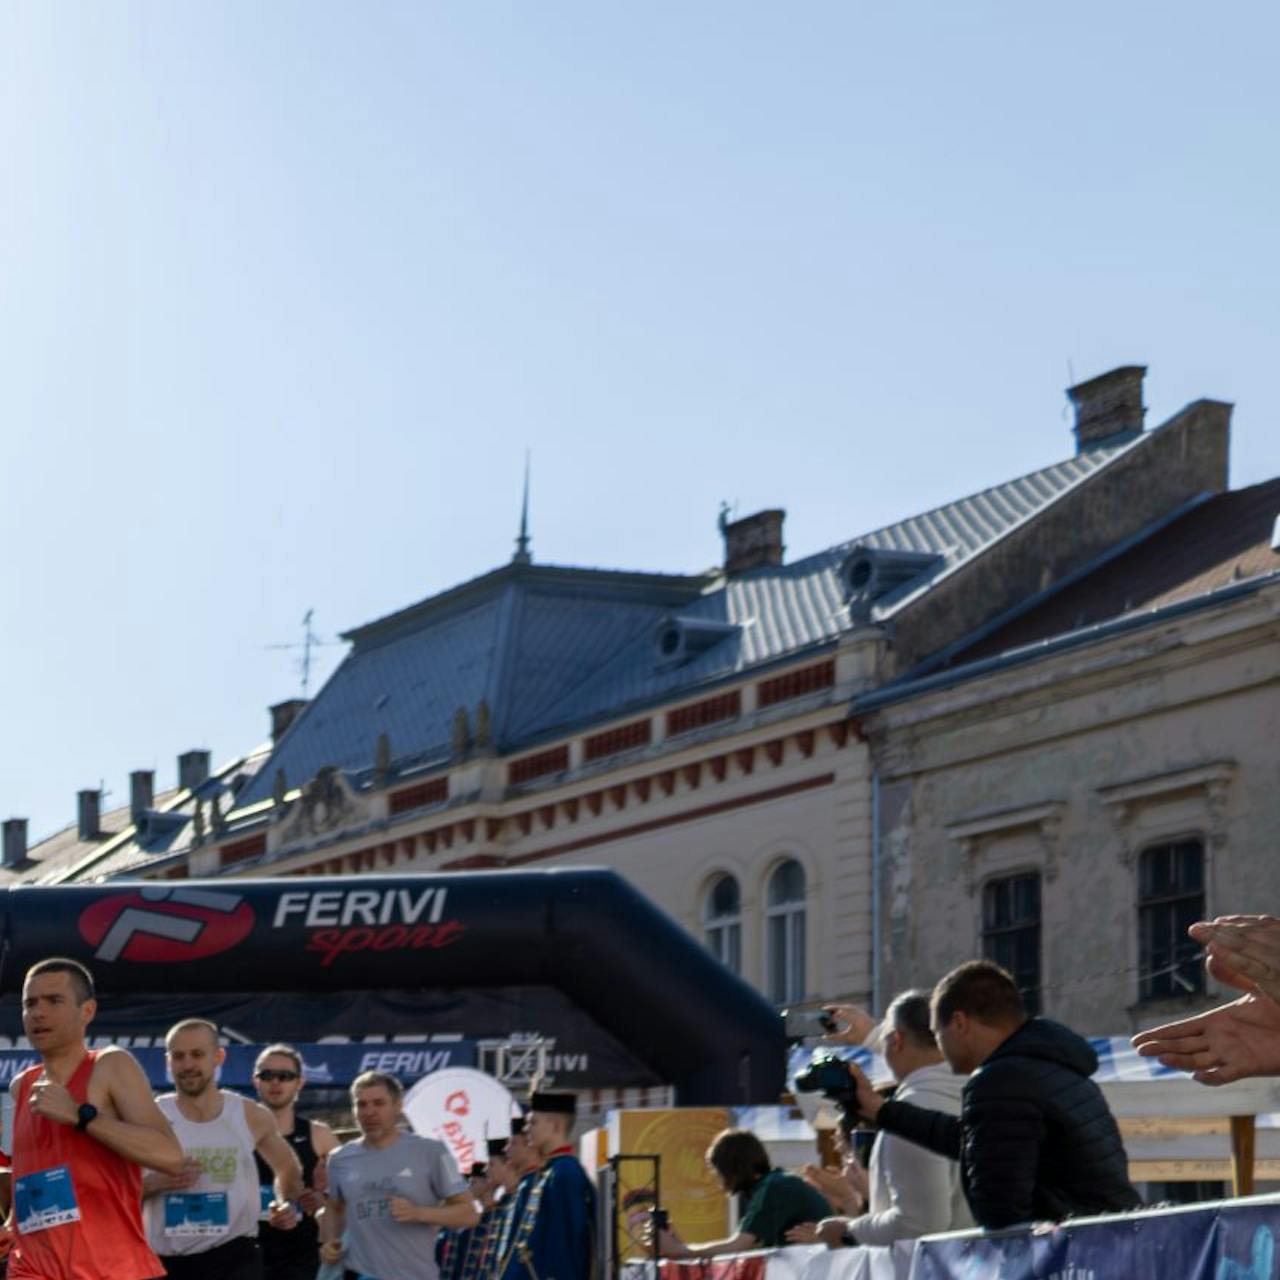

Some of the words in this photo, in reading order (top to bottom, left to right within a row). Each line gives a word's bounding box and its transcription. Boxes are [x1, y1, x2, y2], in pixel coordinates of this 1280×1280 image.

[273, 887, 449, 929] FERIVI
[306, 919, 469, 968] sport
[358, 1050, 451, 1075] FERIVI
